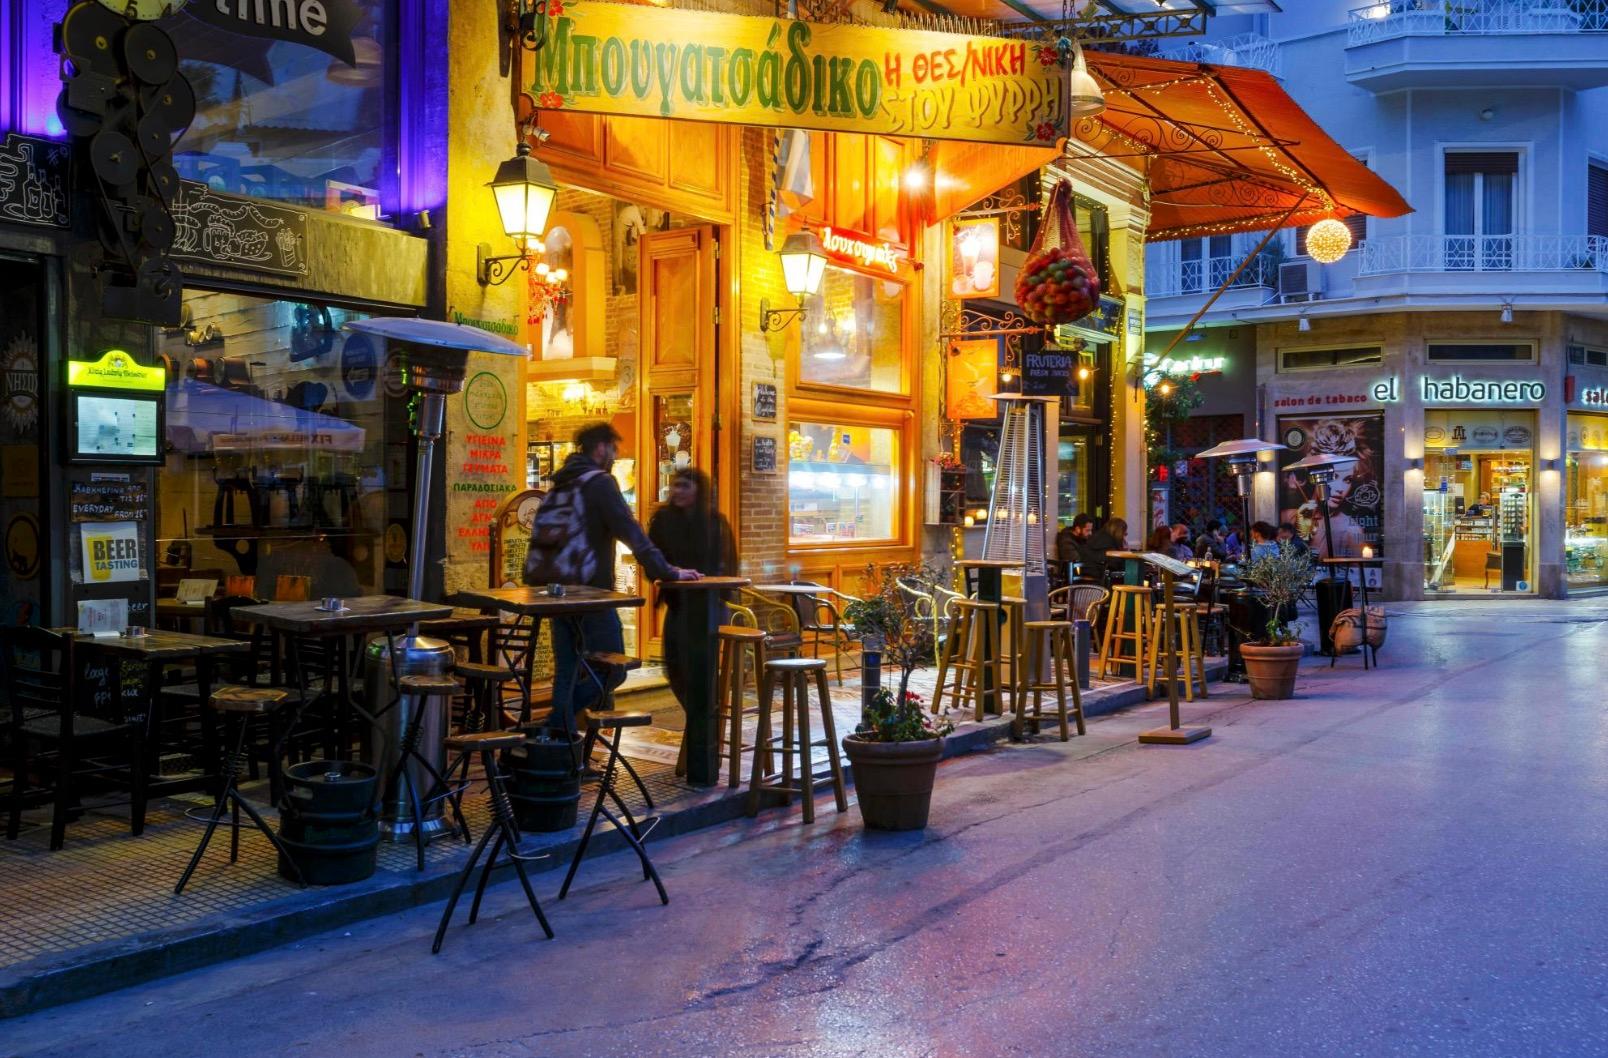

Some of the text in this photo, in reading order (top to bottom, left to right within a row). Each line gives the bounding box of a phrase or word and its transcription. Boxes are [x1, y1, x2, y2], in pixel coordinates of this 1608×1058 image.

[216, 0, 327, 36] me
[533, 15, 882, 118] Μπουγατσάδικο
[884, 41, 1026, 87] Η ΘΕΣ/ΝΙΚΗ
[881, 76, 1062, 133] ΣΤΟΥ ΨΥΡΡΗ
[1026, 354, 1073, 368] FRUTERIA
[1374, 377, 1545, 401] el habanero
[1274, 394, 1367, 408] salon de tabaco
[469, 450, 502, 460] ΜΙΚΡΑ
[453, 483, 517, 493] ΠΑΡΑΔΟΣΙΑΚΑ
[73, 504, 114, 513] EVERYDAY
[475, 499, 497, 508] ΑΠΟ
[93, 538, 137, 560] BEER
[96, 560, 138, 570] TASTING
